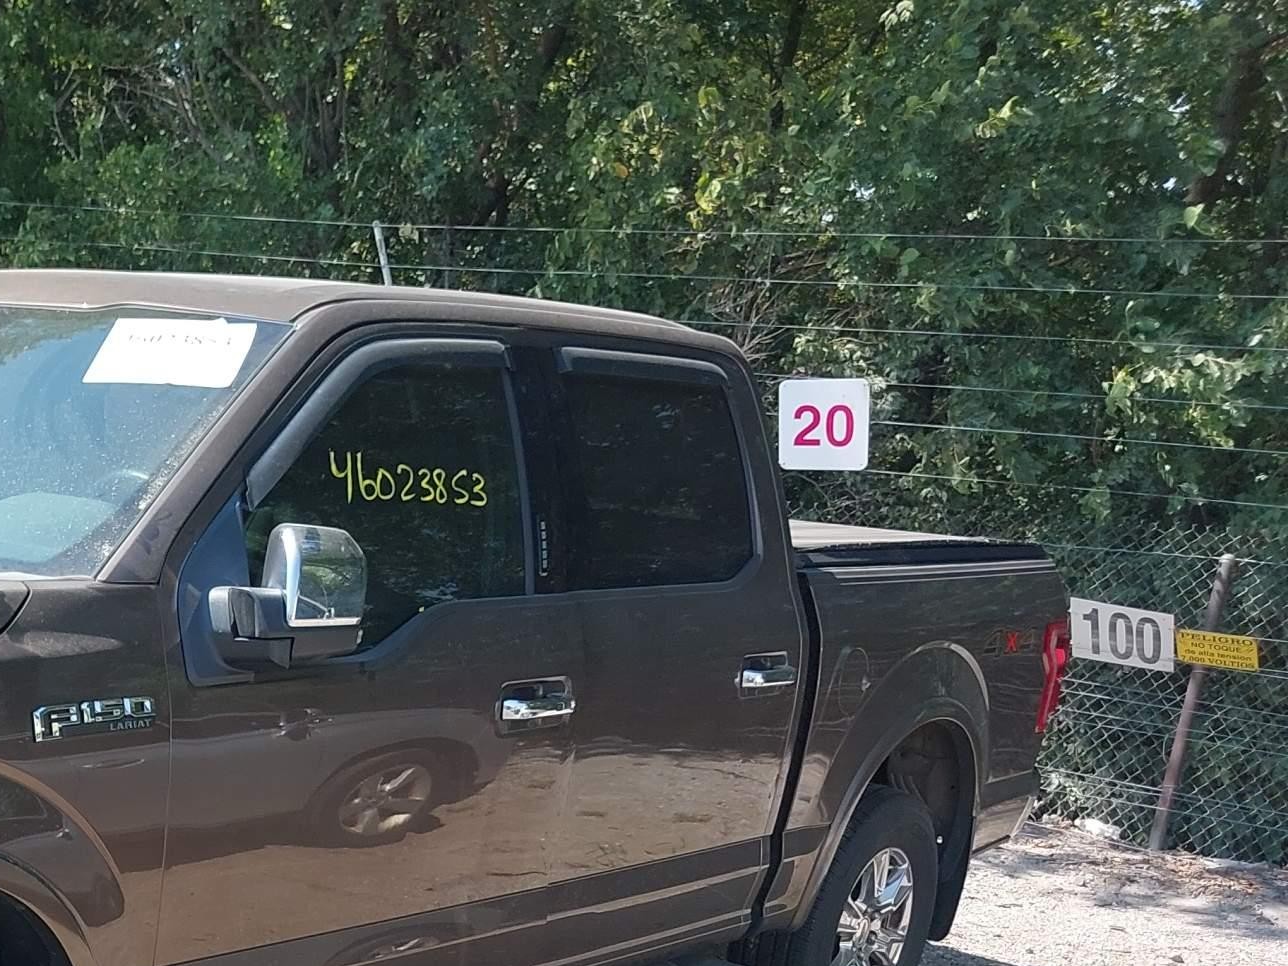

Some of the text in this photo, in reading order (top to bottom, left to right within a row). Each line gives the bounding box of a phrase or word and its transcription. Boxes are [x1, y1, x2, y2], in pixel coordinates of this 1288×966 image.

[793, 404, 854, 447] 20
[328, 449, 488, 507] 46023853
[1082, 607, 1162, 665] 100
[1180, 631, 1253, 646] PELIGRO
[1190, 641, 1205, 649] NO
[109, 719, 152, 731] LARIAT
